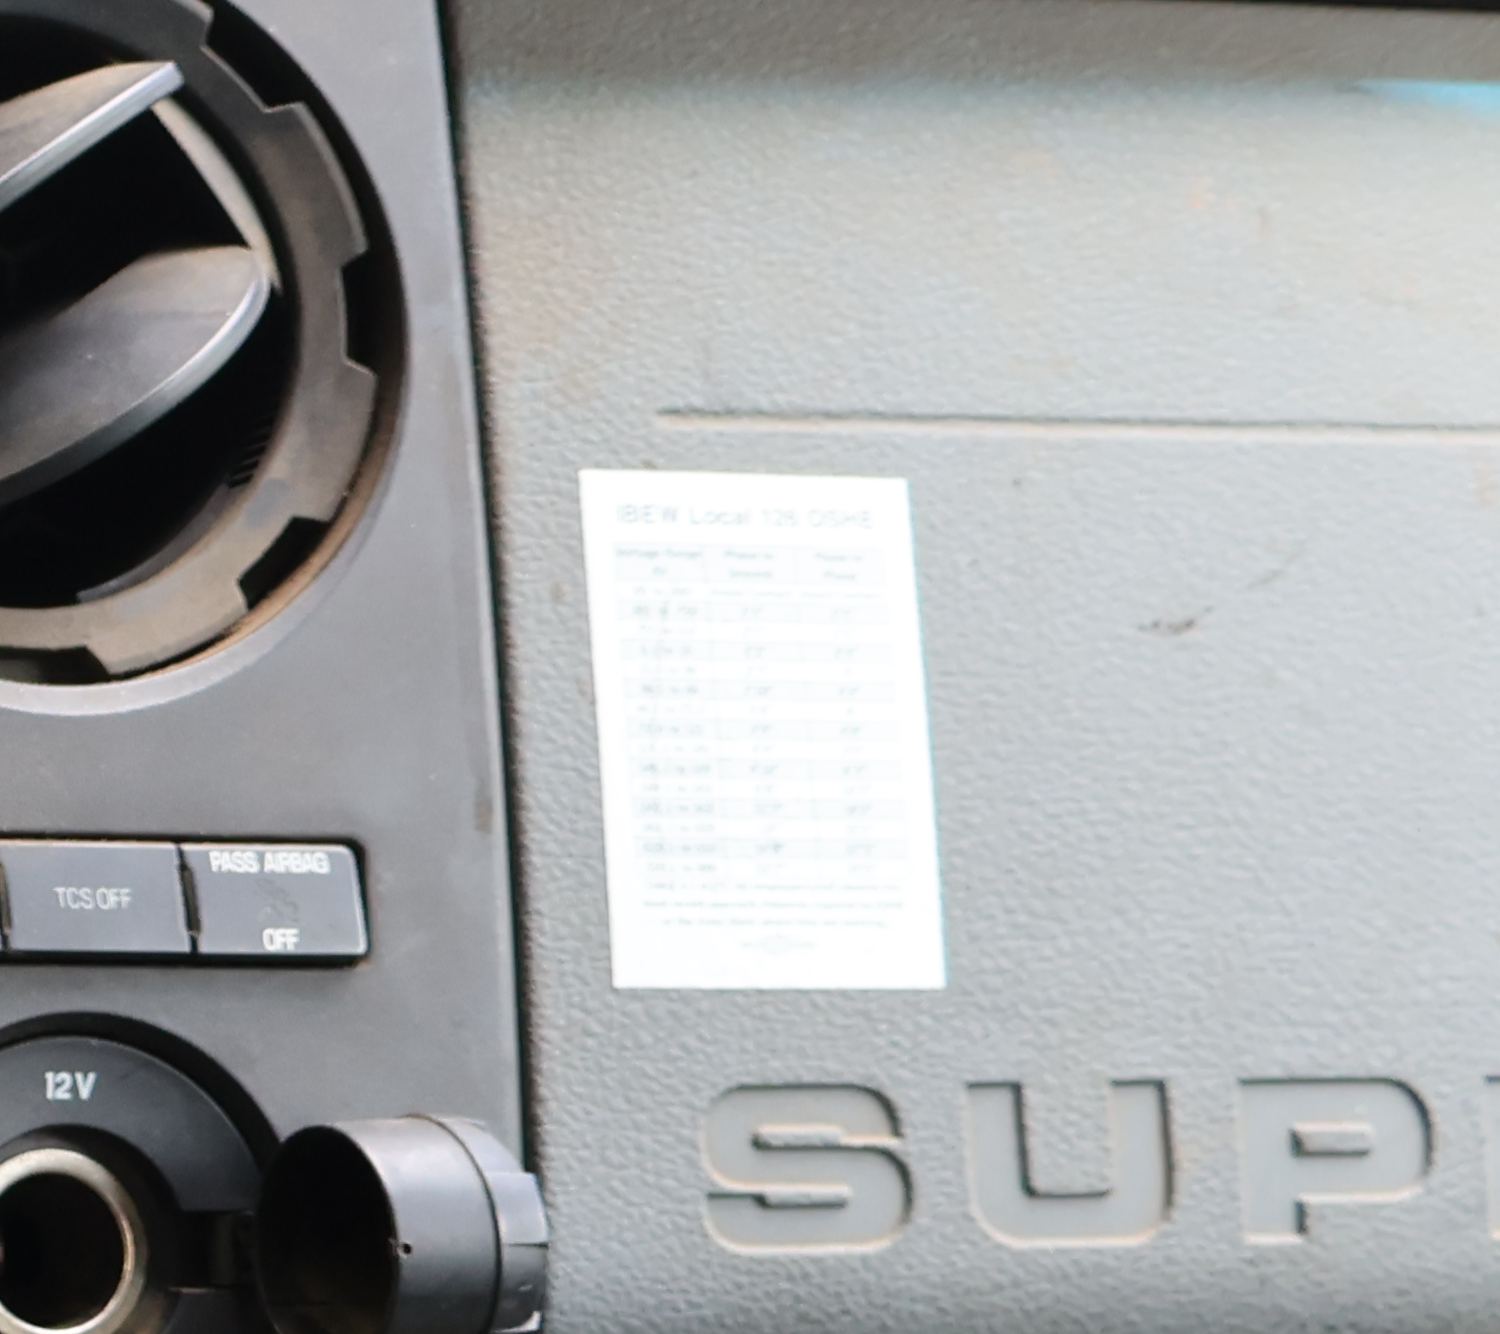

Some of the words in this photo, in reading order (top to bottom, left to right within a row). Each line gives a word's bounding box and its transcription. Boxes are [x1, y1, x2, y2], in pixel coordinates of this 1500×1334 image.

[209, 851, 260, 873] PASS
[264, 851, 331, 874] AIRBAG
[53, 887, 94, 910] TCS
[96, 887, 132, 910] OFF
[262, 928, 299, 951] OFF
[44, 1071, 96, 1101] 12V
[704, 1075, 1500, 1257] SUP
